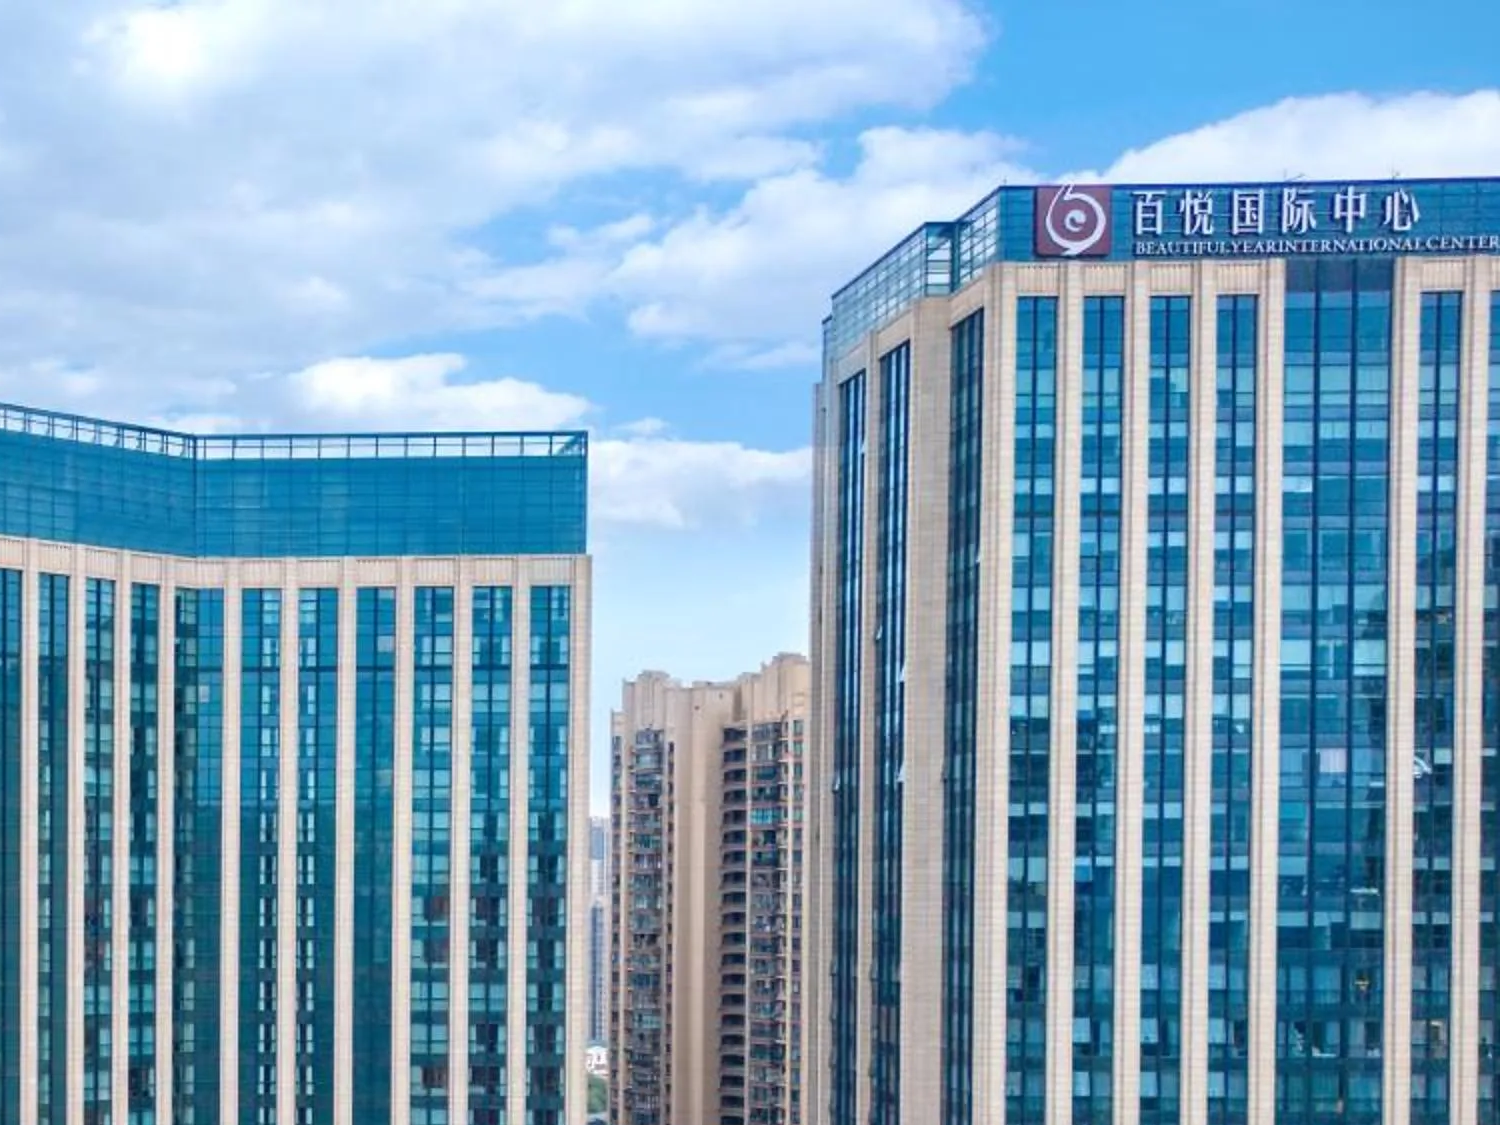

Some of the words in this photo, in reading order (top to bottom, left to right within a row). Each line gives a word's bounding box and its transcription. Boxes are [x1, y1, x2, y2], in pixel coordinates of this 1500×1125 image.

[1132, 186, 1421, 235] 百悦国际中心
